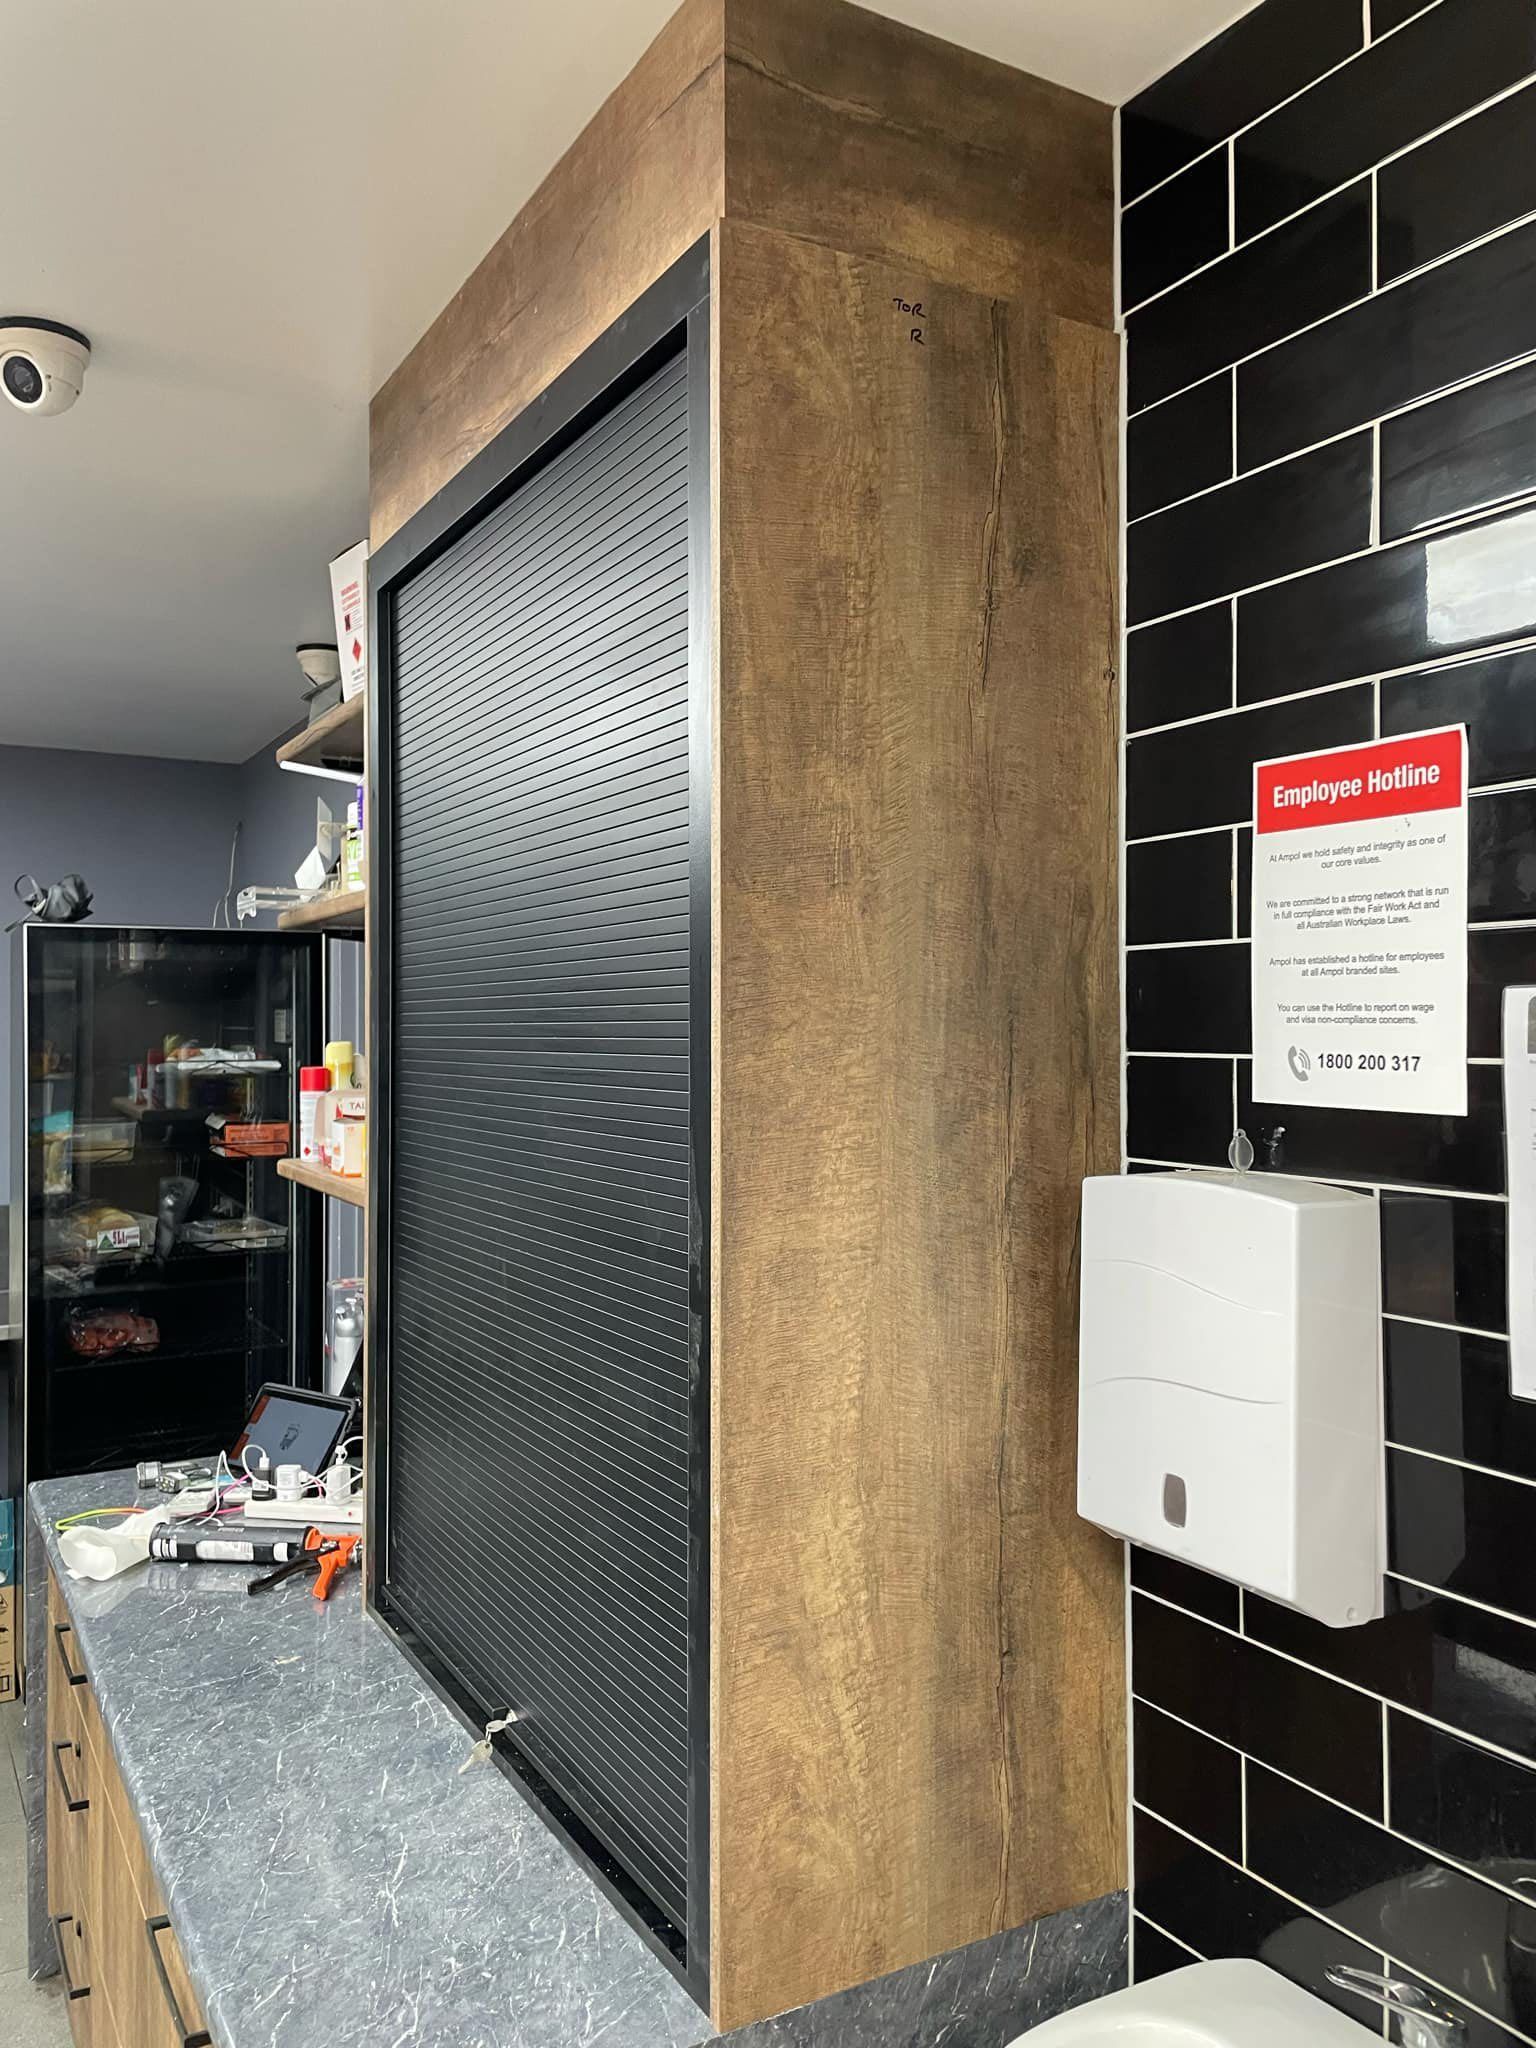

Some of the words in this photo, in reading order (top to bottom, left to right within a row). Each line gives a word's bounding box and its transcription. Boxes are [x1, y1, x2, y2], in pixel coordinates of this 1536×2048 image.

[910, 328, 925, 346] R
[1273, 778, 1362, 808] Employee
[1367, 763, 1440, 793] Hotline
[1269, 854, 1277, 862] At
[1278, 850, 1300, 863] Ampol
[1314, 846, 1330, 857] hold
[1332, 847, 1354, 856] safety
[1356, 842, 1371, 852] and
[1373, 839, 1405, 851] integrity
[1407, 839, 1417, 847] as
[1419, 836, 1435, 845] one
[1437, 834, 1446, 842] of
[1321, 860, 1333, 868] our
[1335, 858, 1352, 867] core
[1354, 855, 1382, 865] values.
[1266, 900, 1277, 908] We
[1279, 900, 1291, 908] are
[1293, 897, 1330, 906] committed
[1332, 895, 1340, 903] to
[1348, 894, 1372, 903] strong
[1374, 891, 1405, 900] network
[1408, 889, 1424, 897] that
[1273, 911, 1280, 919] in
[1281, 910, 1292, 918] full
[1293, 908, 1335, 918] compliance
[1337, 906, 1352, 914] with
[1353, 905, 1366, 913] the
[1368, 903, 1383, 912] Fair
[1385, 901, 1406, 911] Work
[1408, 900, 1422, 909] Act
[1424, 898, 1440, 907] and
[1296, 921, 1305, 929] all
[1307, 918, 1342, 929] Australian
[1345, 916, 1385, 927] Workplace
[1387, 914, 1411, 923] Laws.
[1269, 957, 1291, 967] Ampol
[1293, 956, 1306, 964] has
[1308, 953, 1350, 963] established
[1359, 952, 1385, 961] hotline
[1386, 952, 1398, 960] for
[1399, 952, 1445, 961] employees
[1310, 967, 1318, 975] all
[1320, 966, 1344, 976] Ampol
[1345, 965, 1378, 975] branded
[1379, 965, 1400, 973] sites.
[1277, 1003, 1290, 1011] You
[1321, 1003, 1334, 1011] the
[1335, 1002, 1363, 1011] Hotline
[1364, 1003, 1372, 1011] to
[1374, 1003, 1397, 1013] report
[1412, 1004, 1434, 1013] wage
[1286, 1015, 1299, 1023] and
[1301, 1015, 1316, 1023] visa
[1317, 1015, 1377, 1025] non-compliance
[1378, 1015, 1419, 1024] concerns.
[1317, 1053, 1354, 1070] 1800
[1357, 1055, 1387, 1071] 200
[1390, 1055, 1423, 1072] 317
